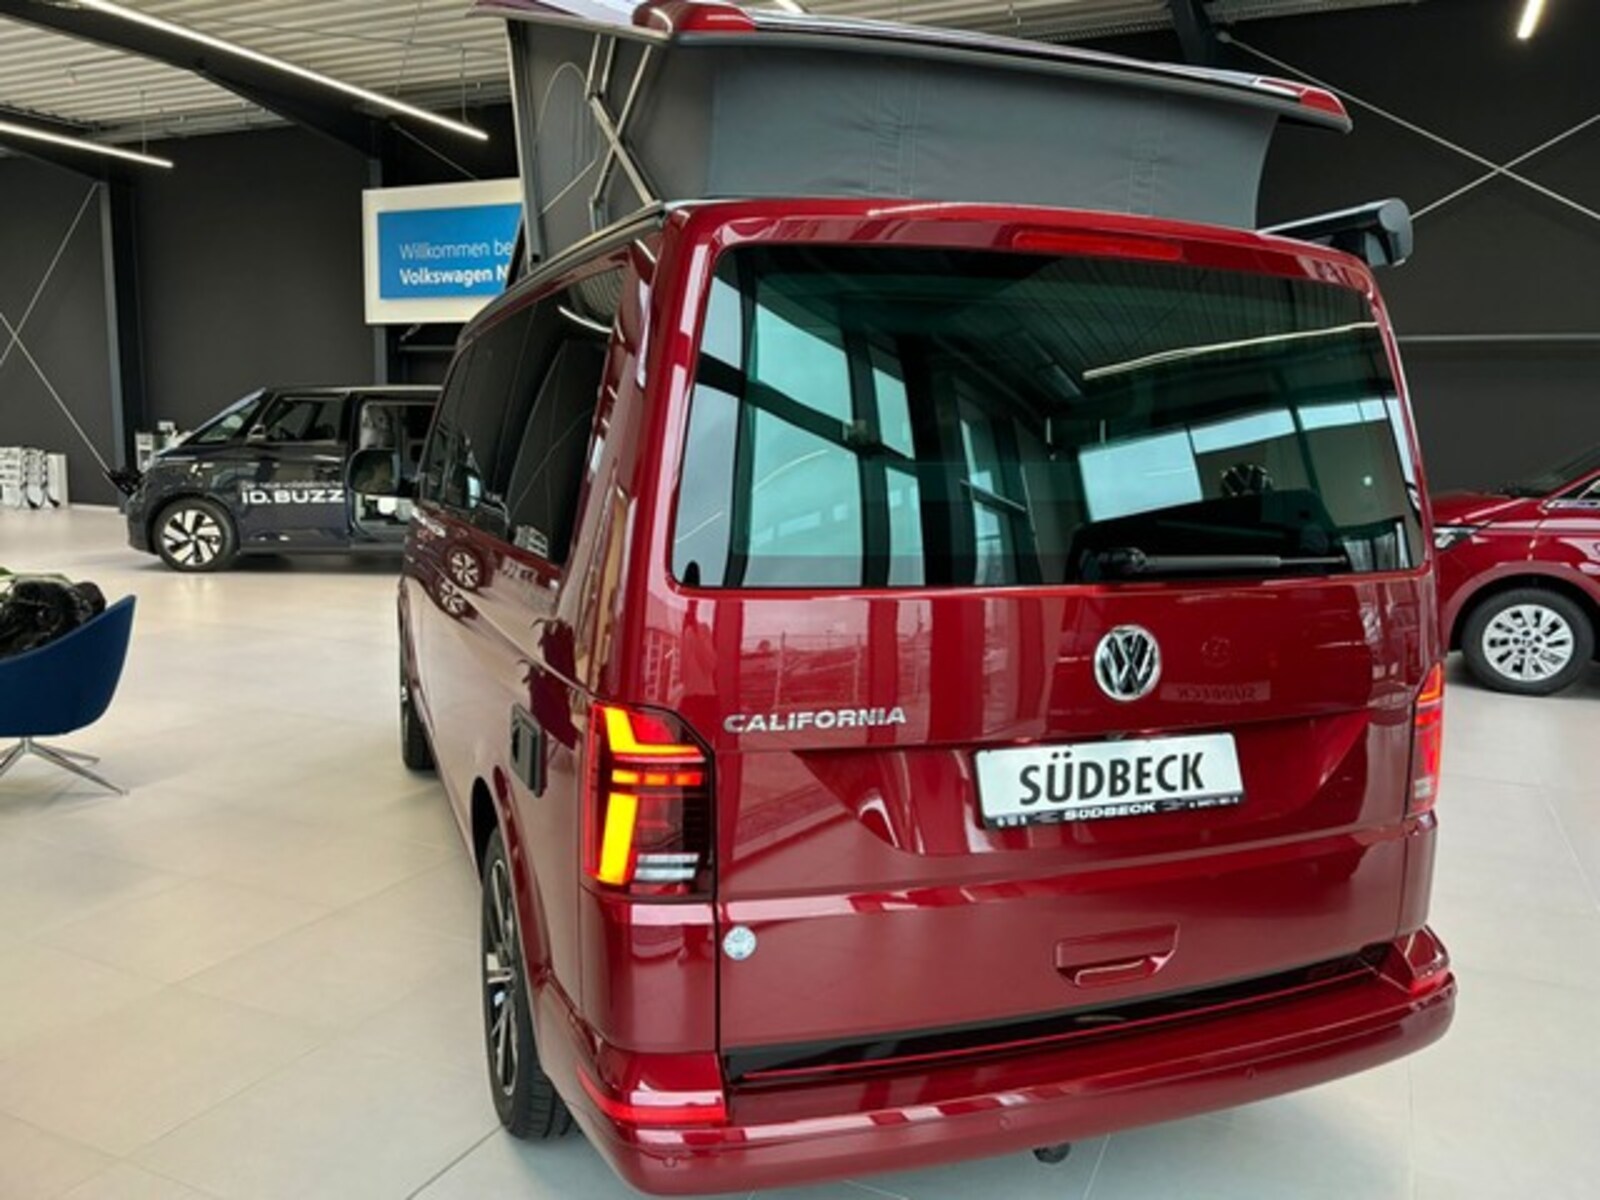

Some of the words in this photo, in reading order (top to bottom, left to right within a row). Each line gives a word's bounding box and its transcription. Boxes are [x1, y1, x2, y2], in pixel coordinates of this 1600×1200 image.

[399, 242, 491, 260] Willkommen
[399, 268, 493, 288] Volkswagen
[723, 706, 907, 734] CALIFORNIA
[1019, 751, 1205, 806] SÜDBECK
[1063, 801, 1157, 822] SÜDBECK
